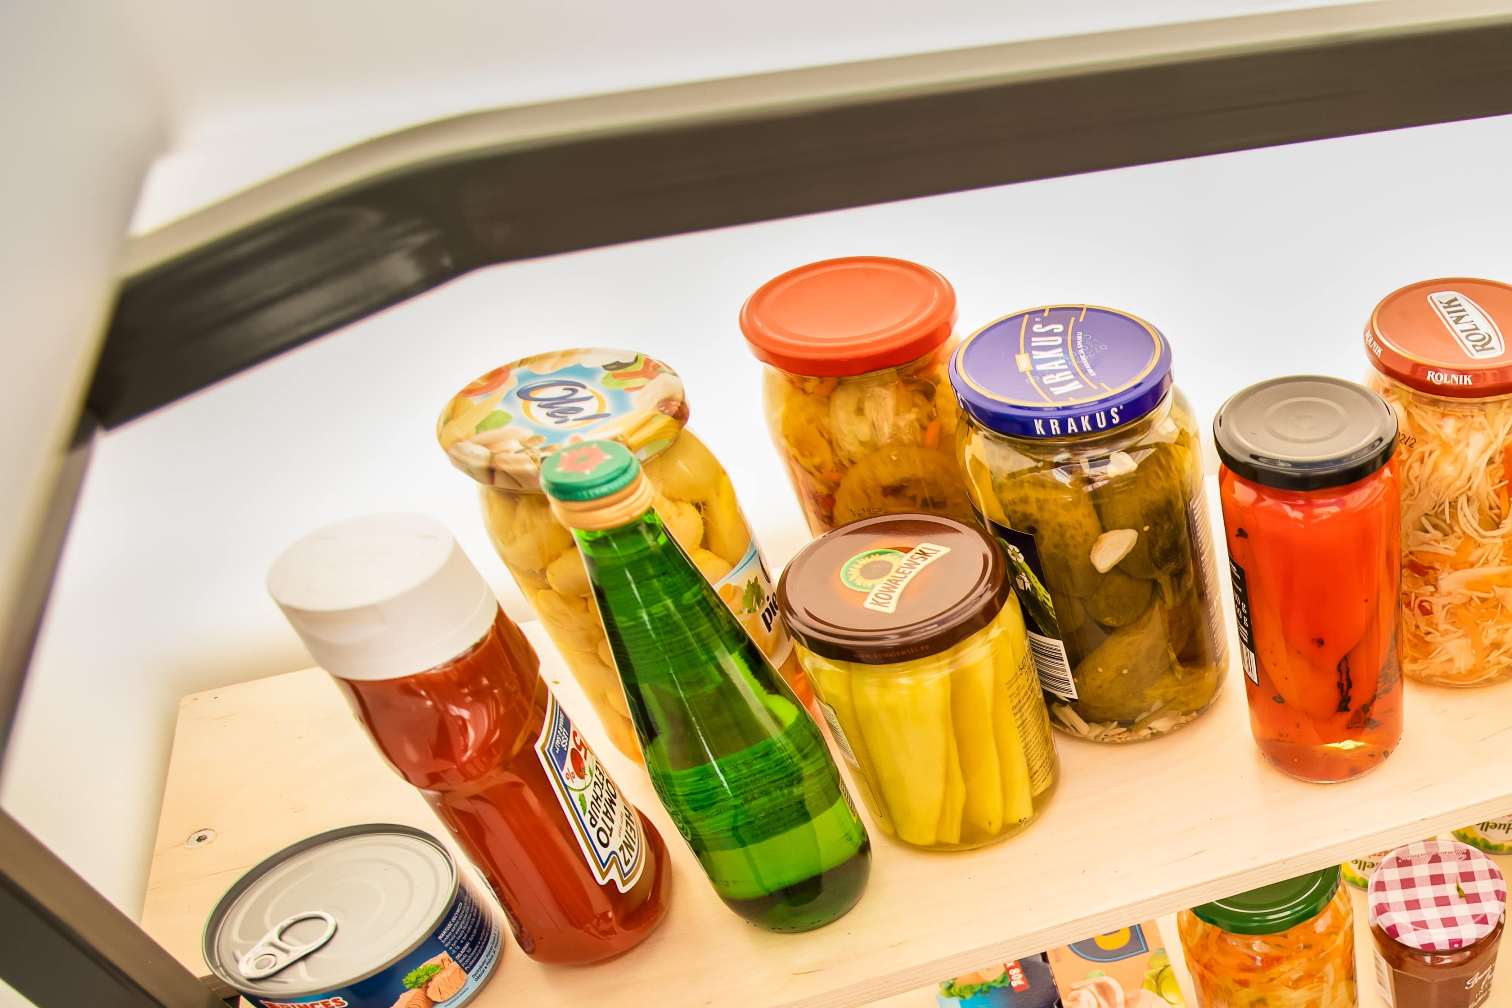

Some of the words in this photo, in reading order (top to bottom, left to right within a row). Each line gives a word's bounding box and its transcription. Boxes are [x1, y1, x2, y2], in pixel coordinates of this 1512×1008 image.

[1440, 297, 1495, 353] ROLNIK
[1031, 322, 1084, 395] KRAKUS
[1426, 370, 1473, 385] ROLNIK
[516, 379, 612, 424] Ole!
[1034, 407, 1122, 435] KRAKUS
[870, 545, 937, 609] KOWALEWSKI
[589, 760, 605, 829] ETCHUP
[596, 777, 617, 849] OMATO
[618, 805, 638, 868] HEINZ
